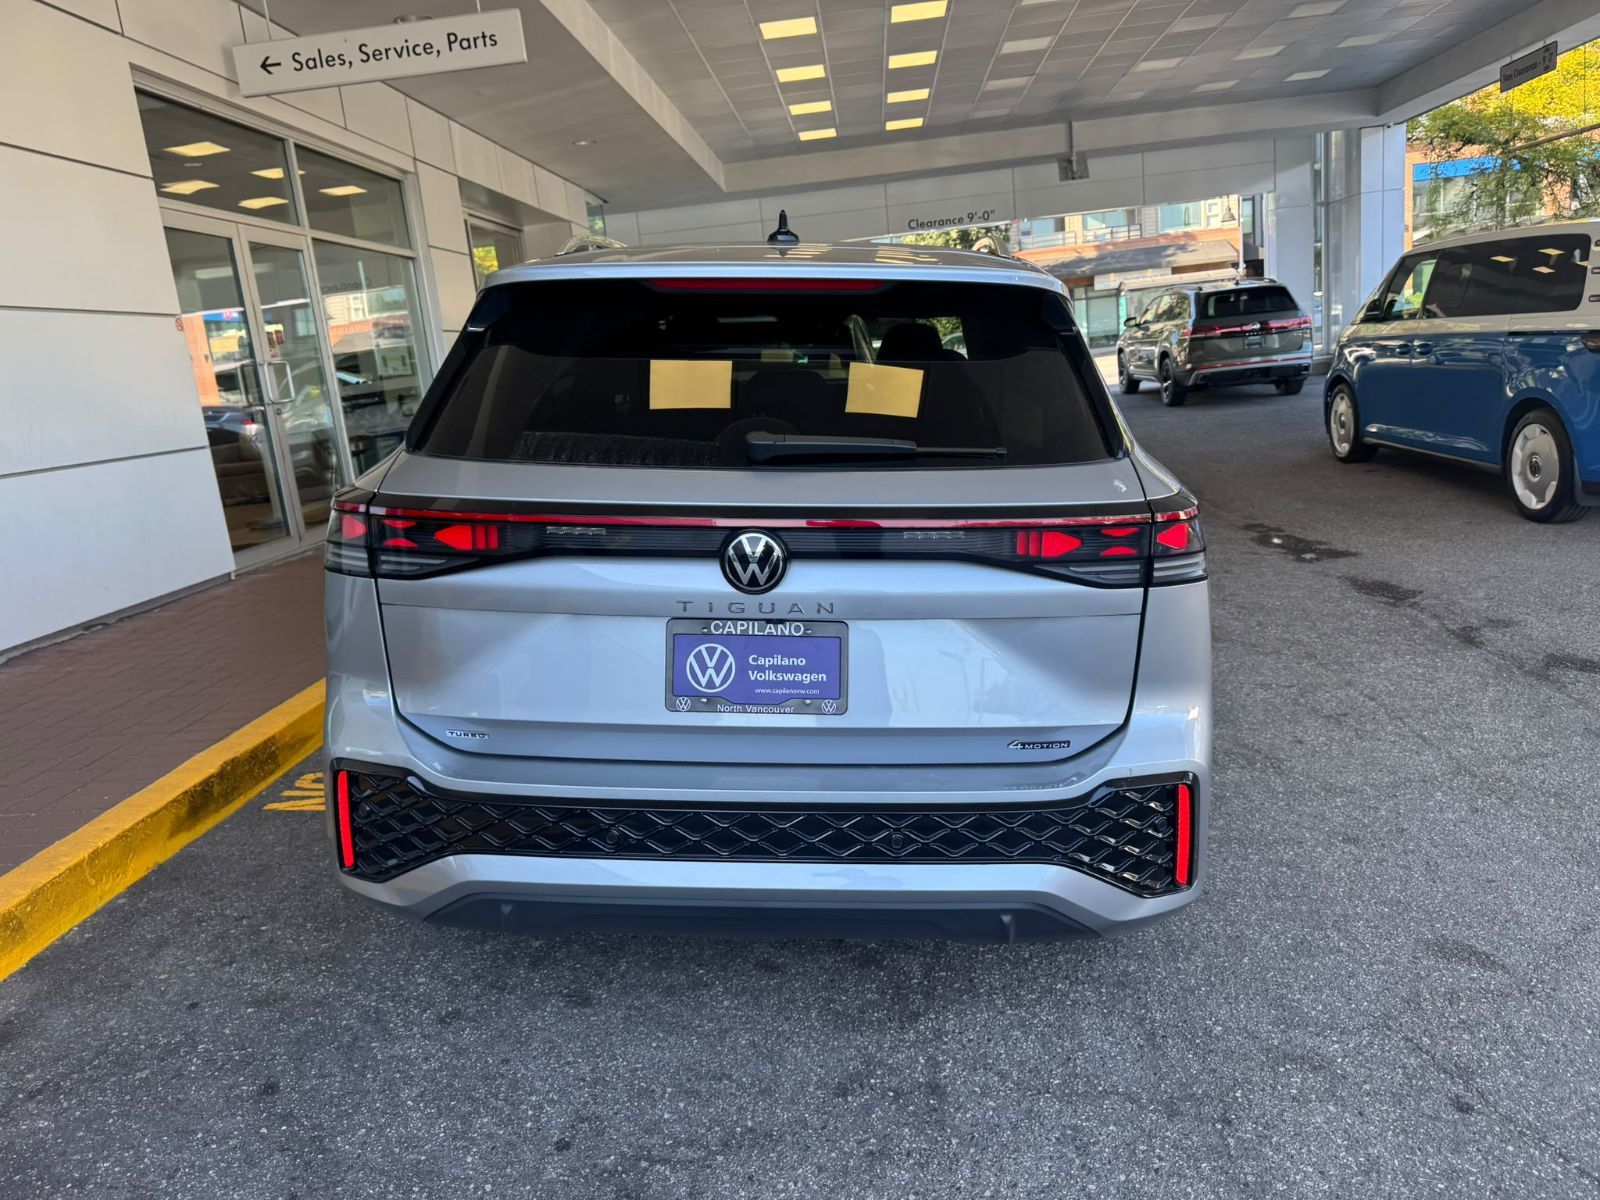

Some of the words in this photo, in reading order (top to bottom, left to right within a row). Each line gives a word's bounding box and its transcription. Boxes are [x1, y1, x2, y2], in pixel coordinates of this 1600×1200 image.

[292, 48, 353, 72] Sales,
[358, 39, 441, 64] Service,
[446, 31, 498, 52] Parts
[907, 216, 964, 230] Clearance
[967, 209, 996, 223] 9'-0"
[676, 600, 834, 614] TIGUAN
[710, 620, 805, 636] CAPILANO
[748, 654, 806, 668] Capilano
[748, 670, 827, 684] Volkswagen
[755, 687, 820, 695] www.capilanovw.com
[717, 704, 743, 713] North
[745, 704, 795, 714] Vancouver
[446, 730, 489, 740] TURBO
[1008, 740, 1069, 749] 4MOTION
